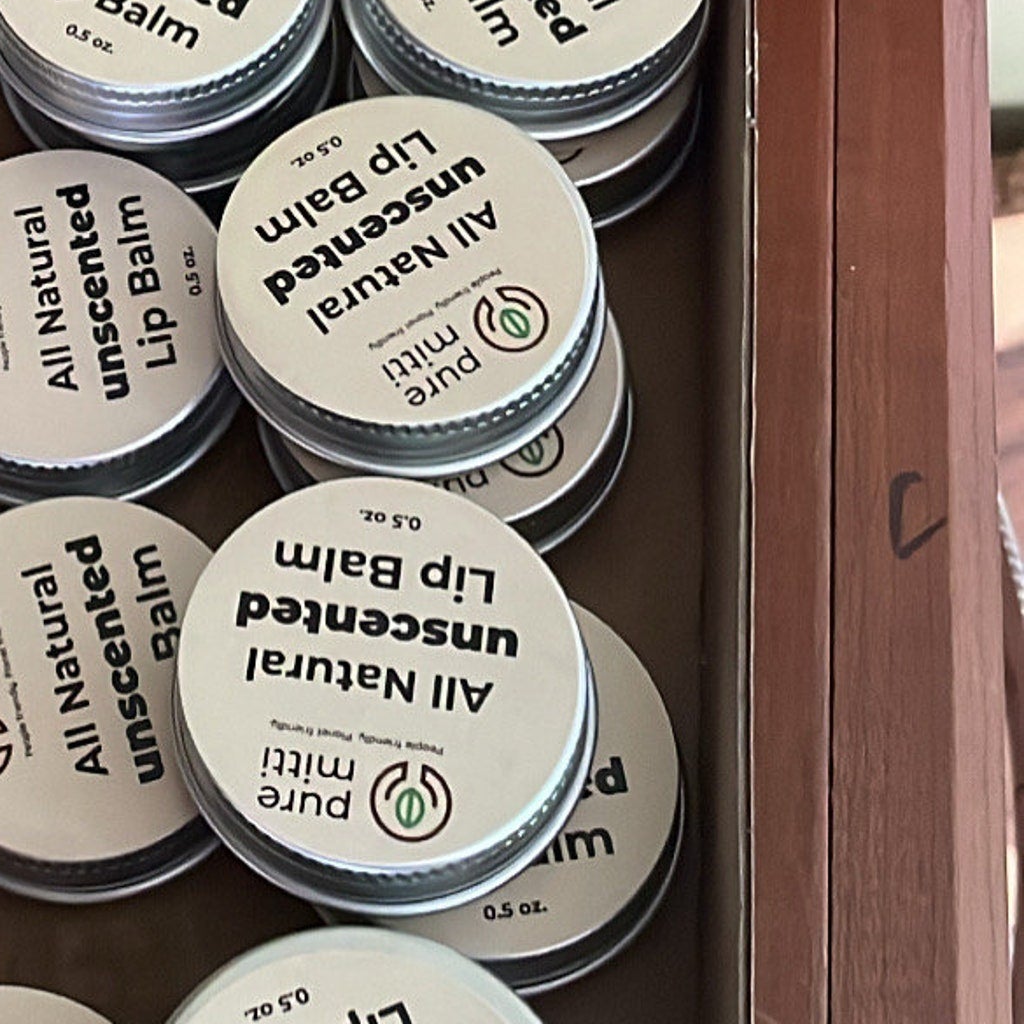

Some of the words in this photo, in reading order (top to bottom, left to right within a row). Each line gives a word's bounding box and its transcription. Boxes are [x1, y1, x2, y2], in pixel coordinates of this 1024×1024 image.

[64, 23, 92, 42] 0.5
[91, 37, 114, 54] oz.
[289, 150, 315, 167] oz.
[315, 134, 343, 157] 0.5
[367, 128, 437, 176] Lip
[253, 169, 368, 243] Balm
[262, 155, 486, 306] unscented
[446, 198, 497, 249] All
[116, 193, 162, 297] Balm
[182, 244, 197, 268] oz.
[13, 205, 67, 336] Natural
[55, 182, 131, 401] unscented
[185, 270, 203, 296] 0.5
[305, 234, 449, 335] Natural
[136, 305, 179, 369] Lip
[379, 323, 460, 388] mitti
[39, 344, 80, 391] All
[403, 344, 482, 406] pure
[358, 508, 387, 523] oz.
[390, 512, 422, 531] 0.5
[274, 539, 403, 591] Balm
[419, 553, 496, 604] Lip
[234, 589, 518, 657] unscented
[244, 646, 416, 703] Natural
[430, 673, 495, 713] All
[259, 744, 356, 784] mitti
[256, 783, 352, 820] pure
[483, 902, 514, 920] 0.5
[519, 900, 548, 916] oz.
[277, 986, 310, 1013] 0.5
